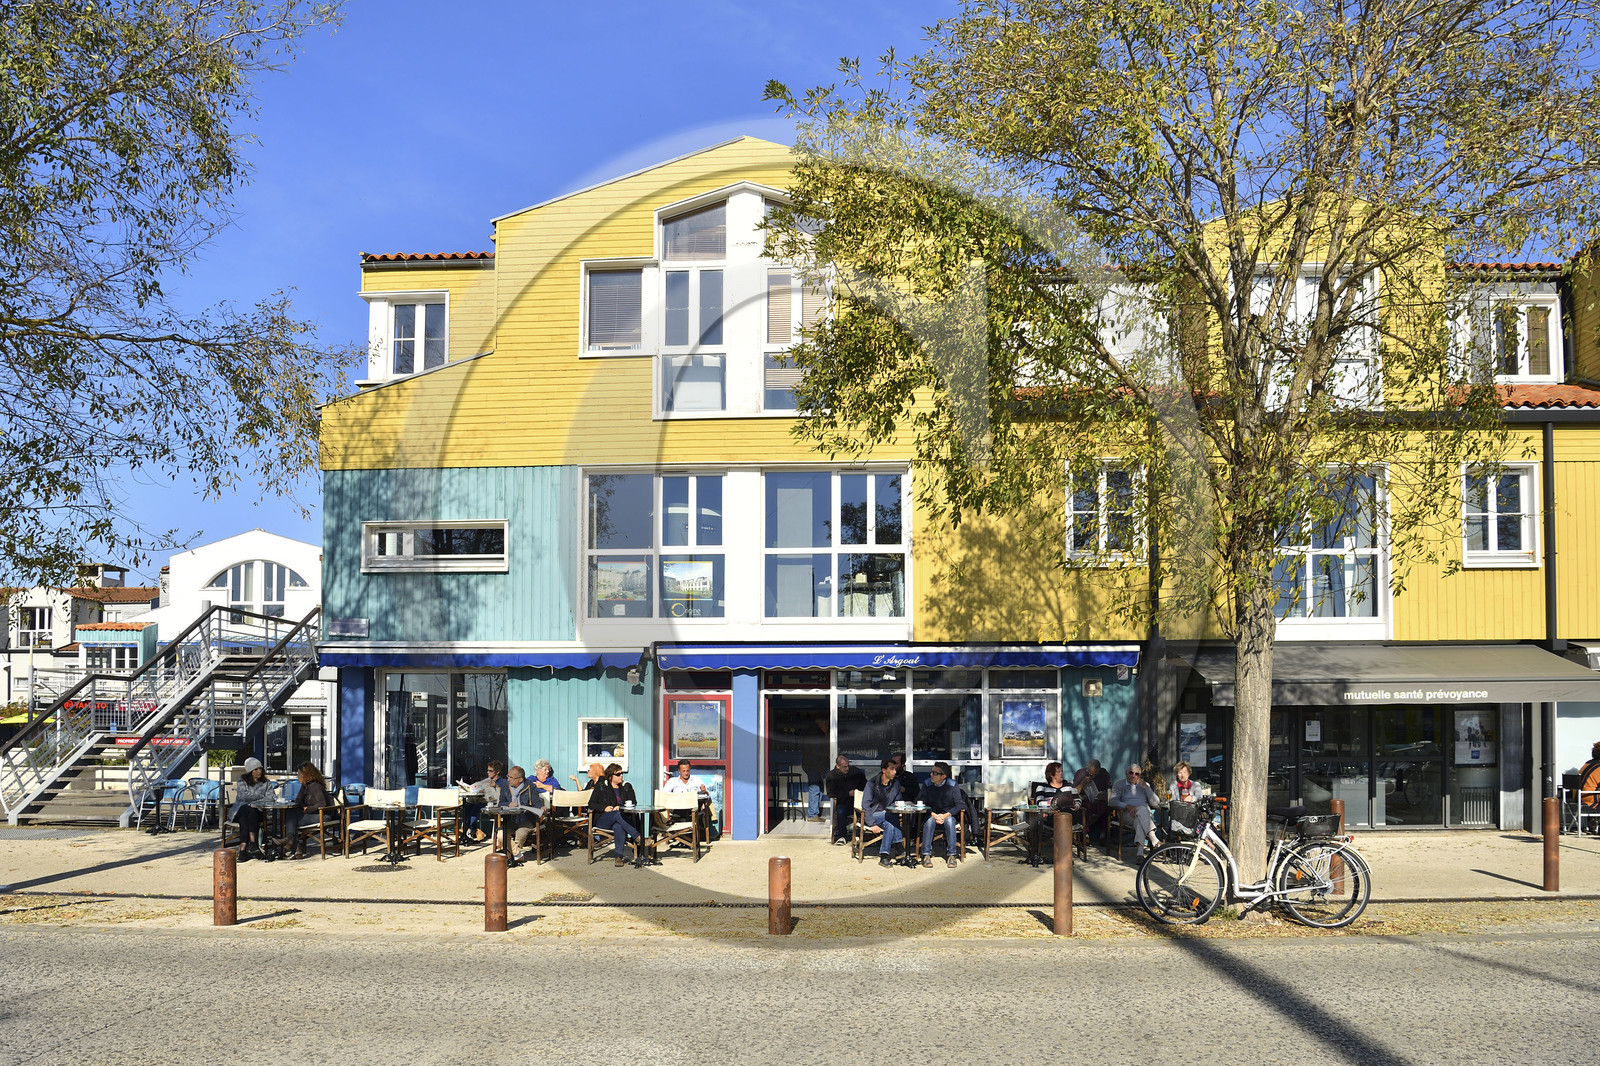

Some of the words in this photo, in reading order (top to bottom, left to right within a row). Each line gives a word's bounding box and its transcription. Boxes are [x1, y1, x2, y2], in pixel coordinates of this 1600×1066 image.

[1344, 689, 1391, 699] mutuelle
[1393, 689, 1423, 699] santé
[1426, 689, 1488, 701] prévoyance
